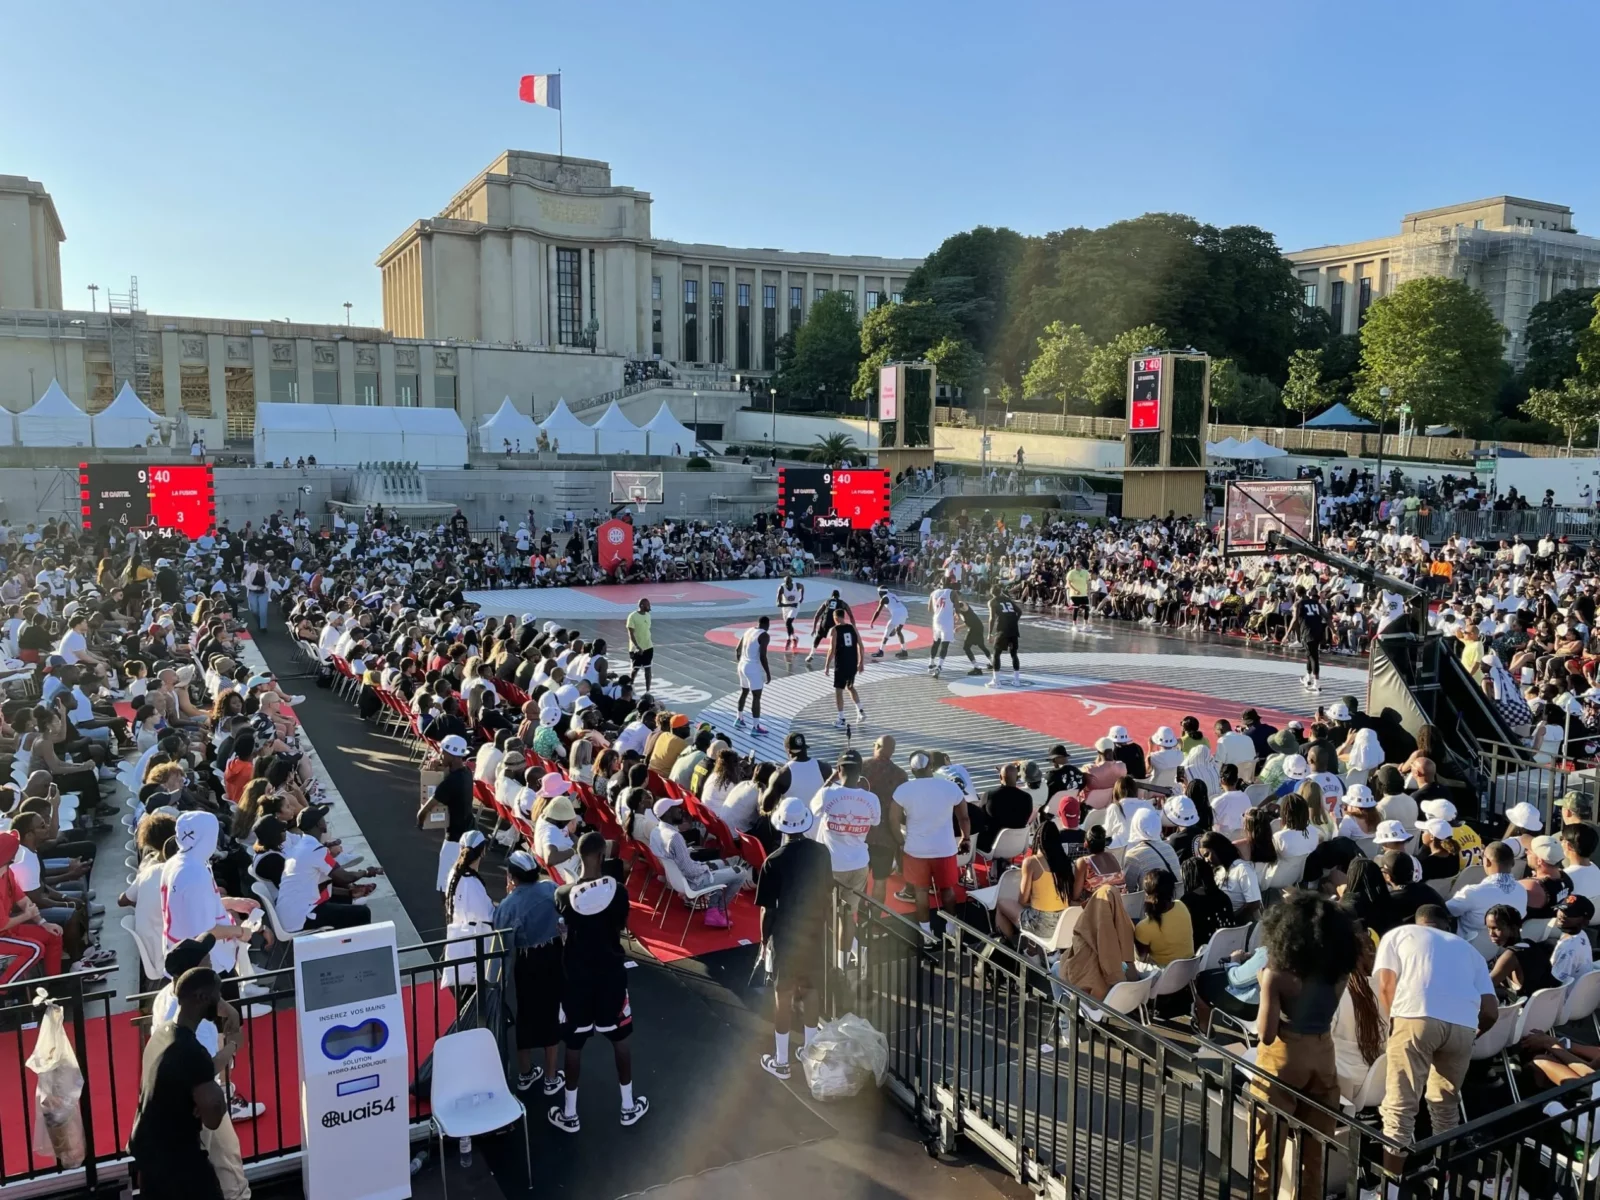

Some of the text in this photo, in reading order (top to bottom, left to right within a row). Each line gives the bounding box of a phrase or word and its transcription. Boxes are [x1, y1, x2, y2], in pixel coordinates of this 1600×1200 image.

[1139, 360, 1160, 370] 9:40
[1139, 418, 1144, 427] 3
[138, 470, 170, 483] 9:40
[823, 473, 851, 484] 9:40
[854, 505, 861, 515] 3
[119, 512, 128, 526] 4
[177, 511, 184, 523] 3
[829, 600, 837, 610] 9
[1000, 602, 1015, 613] 12
[1304, 603, 1320, 616] 14
[1325, 796, 1338, 812] 7
[848, 825, 867, 833] FIRST
[1459, 834, 1476, 846] JAMES
[350, 1007, 365, 1016] VOS
[365, 1003, 386, 1013] MAINS
[327, 1058, 388, 1076] HYDRO-ALCOOLIQUE
[342, 1055, 372, 1067] SOLUTION
